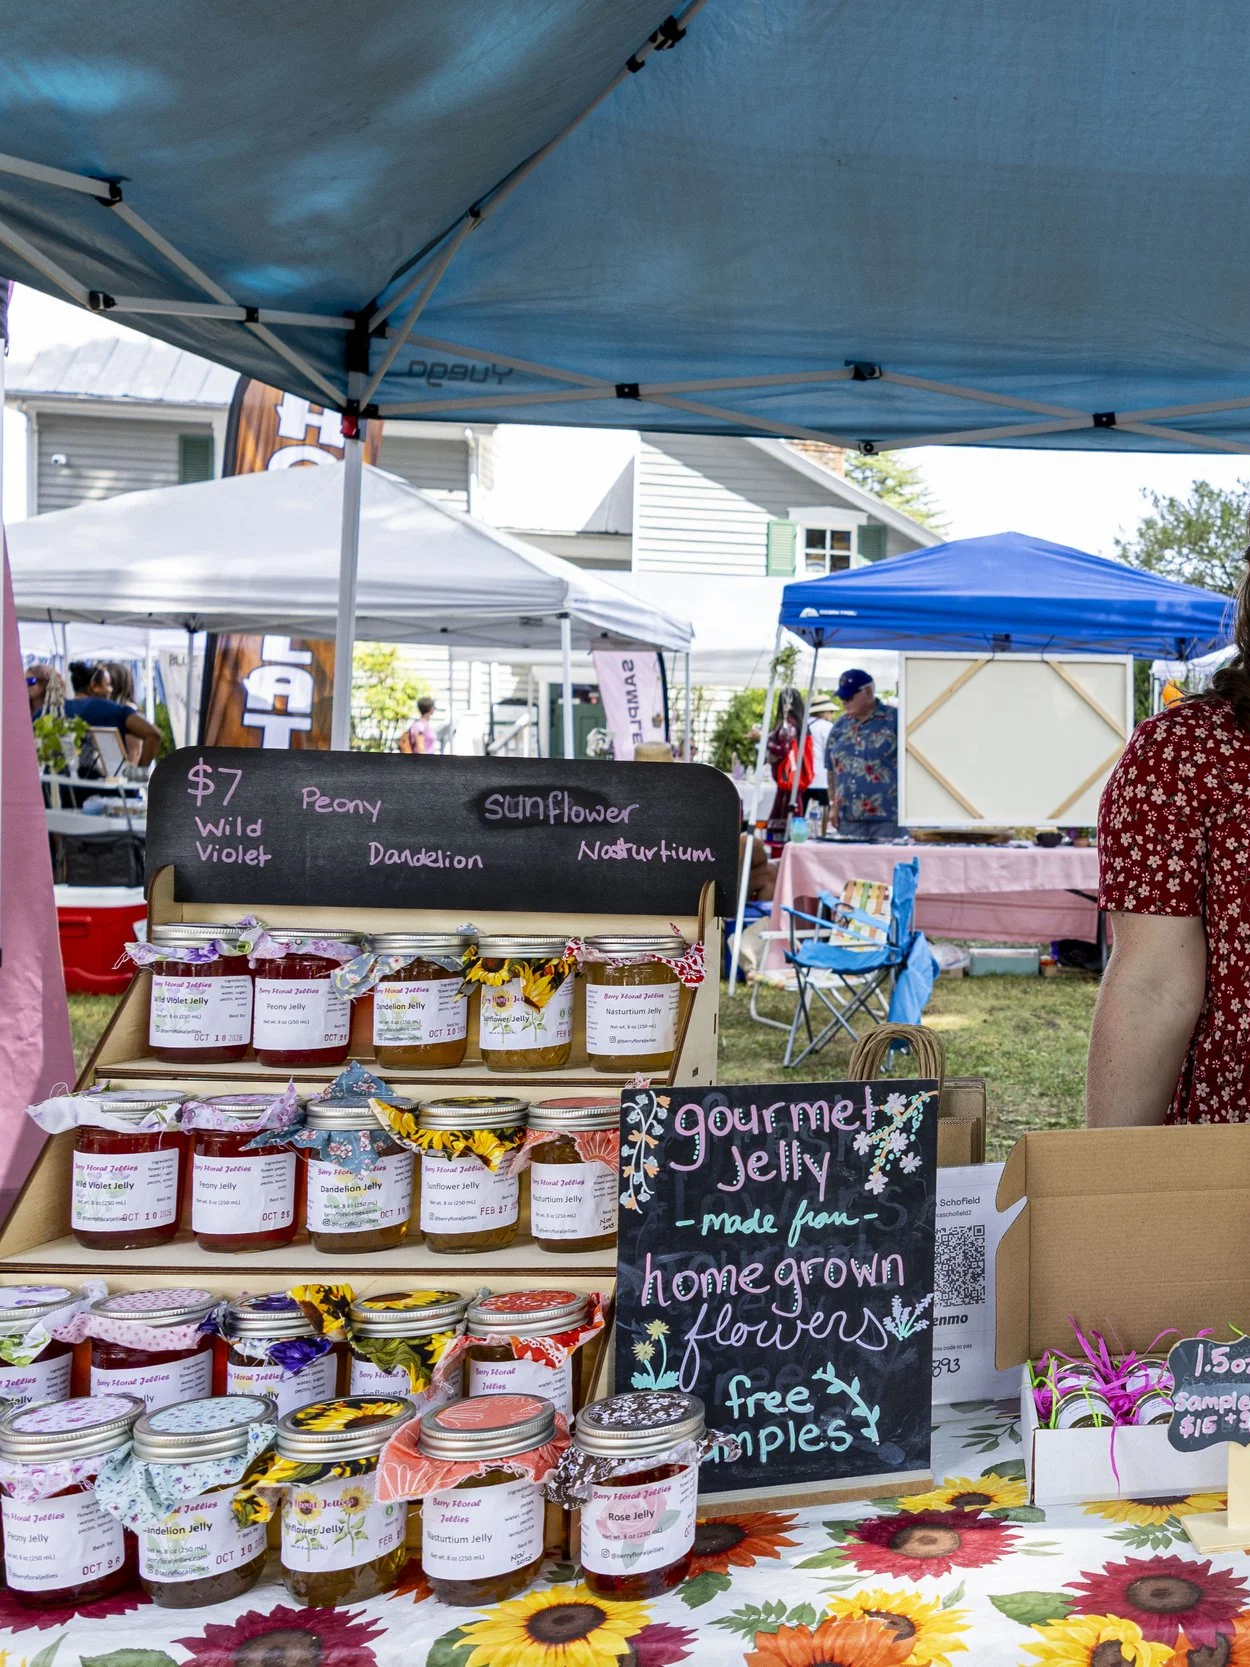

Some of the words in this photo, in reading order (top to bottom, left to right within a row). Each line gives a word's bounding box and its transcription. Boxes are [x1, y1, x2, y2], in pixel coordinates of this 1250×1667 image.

[187, 757, 242, 806] $7
[302, 786, 381, 823] Peony
[195, 816, 262, 837] Wild
[196, 841, 272, 867] Violet
[368, 841, 483, 869] Dandelion
[189, 997, 208, 1006] Jelly
[289, 1003, 306, 1011] Jelly
[195, 1034, 209, 1042] OCT
[324, 1034, 337, 1042] OCT
[429, 1029, 443, 1037] OCT
[670, 1086, 882, 1171] gourmet
[717, 1140, 831, 1201] jelly
[114, 1182, 134, 1190] Jelly
[200, 1181, 217, 1189] Peony
[220, 1182, 236, 1190] Jelly
[364, 1182, 382, 1191] Jelly
[427, 1182, 459, 1190] Sunflower
[462, 1182, 480, 1190] Jelly
[565, 1195, 582, 1204] Jelly
[940, 1196, 980, 1206] Schofield
[381, 1210, 393, 1218] OCT
[480, 1206, 495, 1216] FEB
[936, 1210, 971, 1218] aschofield2
[122, 1213, 138, 1221] OCT
[263, 1212, 277, 1221] OCT
[933, 1314, 968, 1326] enmo
[679, 1302, 888, 1392] flowers
[140, 1375, 169, 1385] Jellies
[725, 1374, 814, 1419] free
[1180, 1414, 1217, 1438] $15
[703, 1420, 853, 1464] mples
[593, 1492, 612, 1500] Berry
[614, 1492, 640, 1500] Floral
[644, 1486, 671, 1498] Jellies
[452, 1499, 481, 1507] Floral
[441, 1514, 469, 1523] Jellies
[608, 1512, 630, 1521] Rose
[633, 1510, 655, 1520] Jelly
[189, 1522, 212, 1532] Jelly
[320, 1525, 344, 1534] Jelly
[28, 1534, 48, 1543] Jelly
[379, 1535, 392, 1548] FEB
[472, 1534, 492, 1543] Jelly
[216, 1551, 234, 1564] OCT
[83, 1562, 101, 1575] OCT
